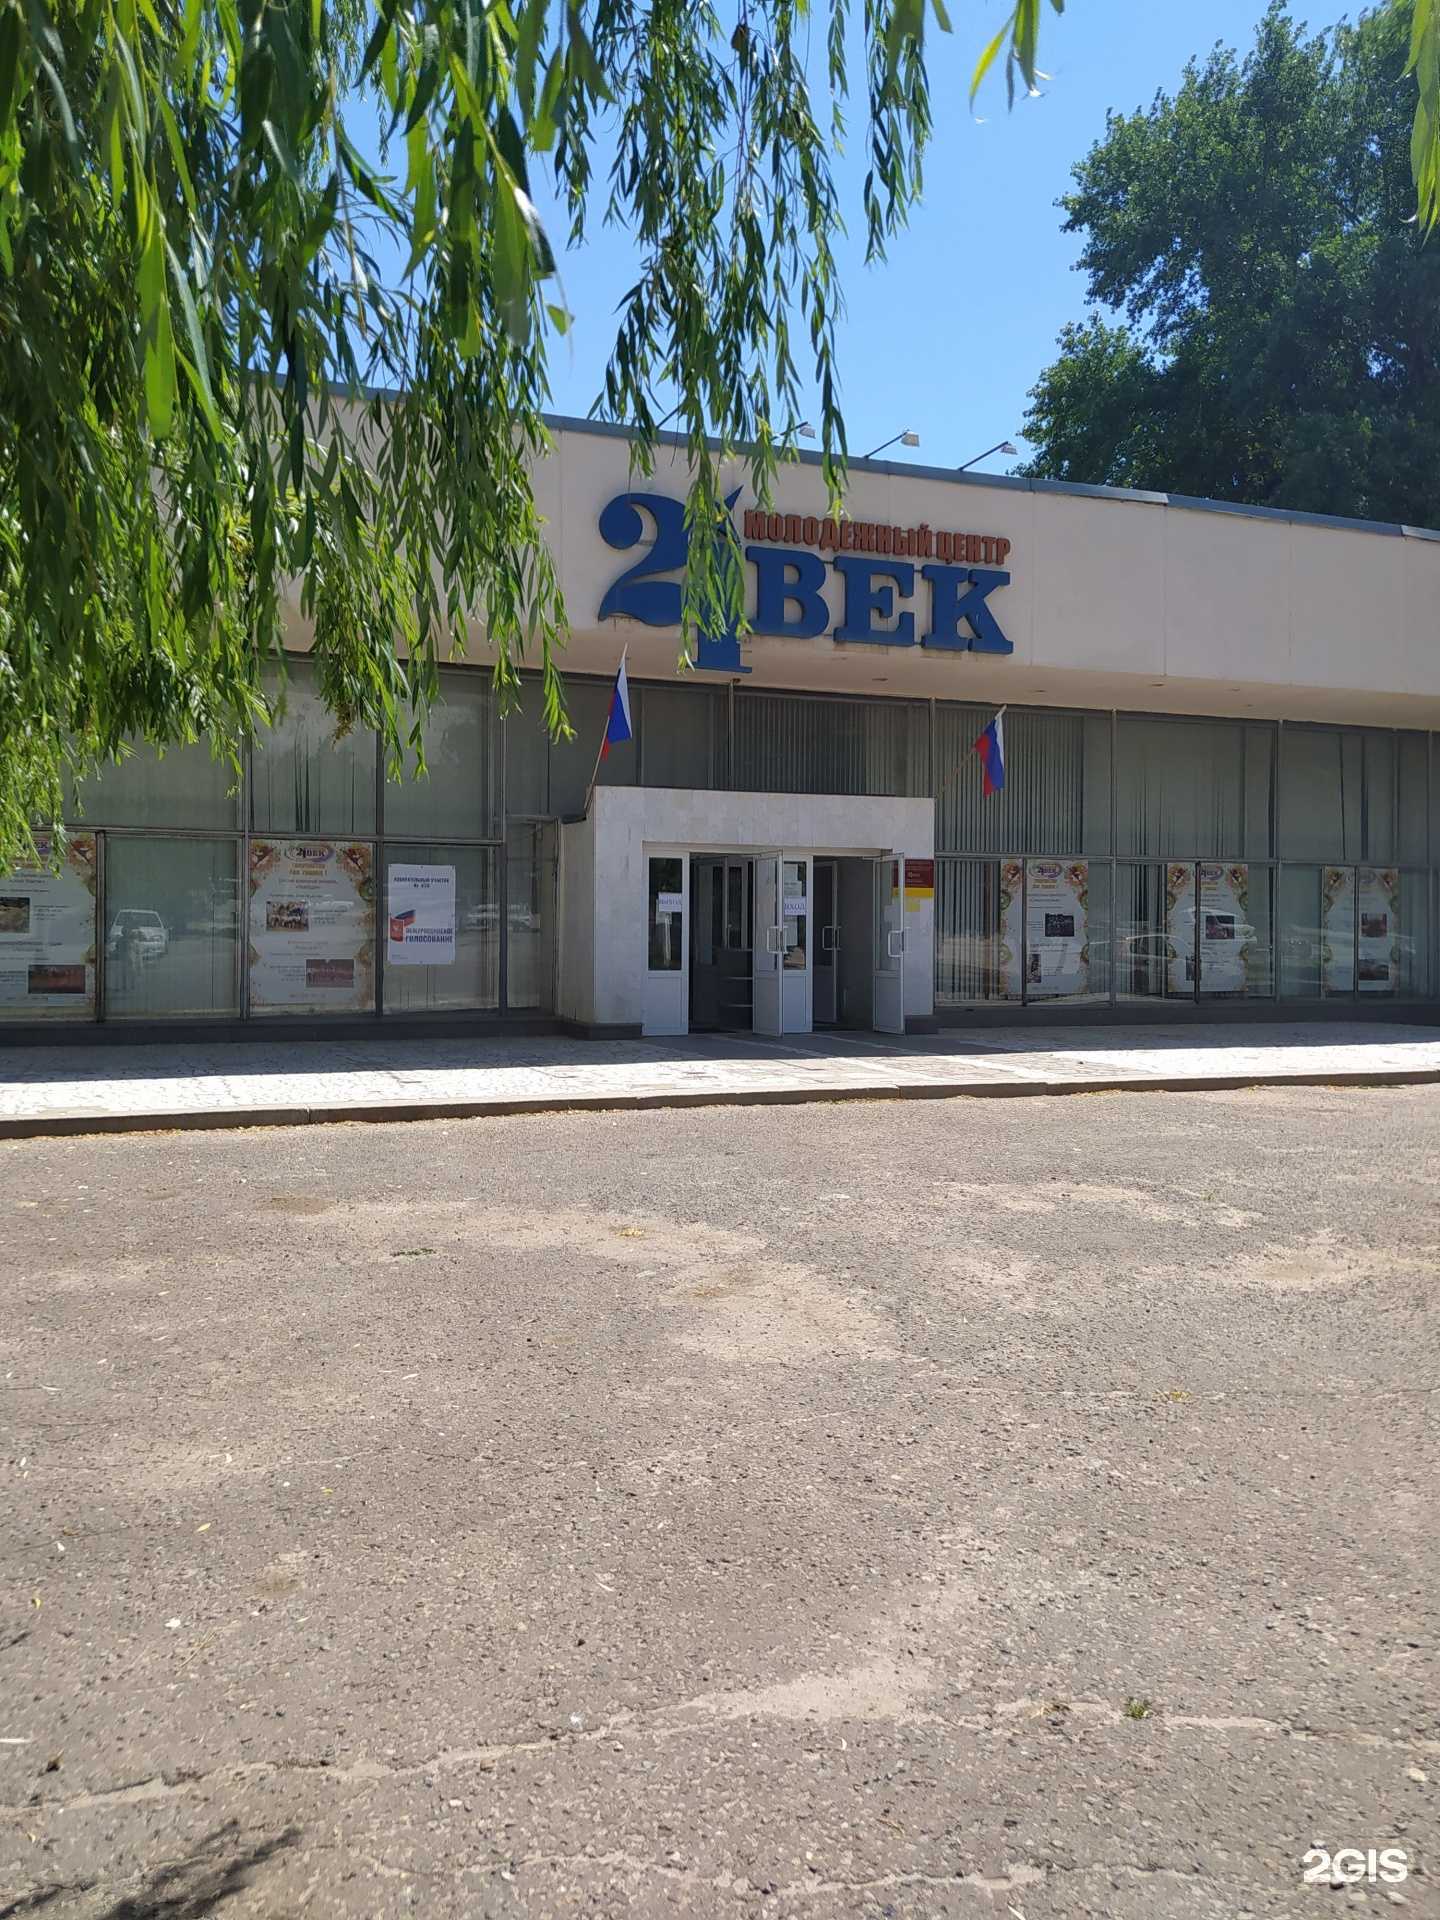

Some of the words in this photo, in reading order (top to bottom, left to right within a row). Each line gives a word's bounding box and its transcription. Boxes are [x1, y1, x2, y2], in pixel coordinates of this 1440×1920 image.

[743, 509, 933, 559] МОЛОДЕЖНЫЙ
[935, 530, 1011, 566] ЦЕНТР
[745, 546, 1014, 655] ВЕК
